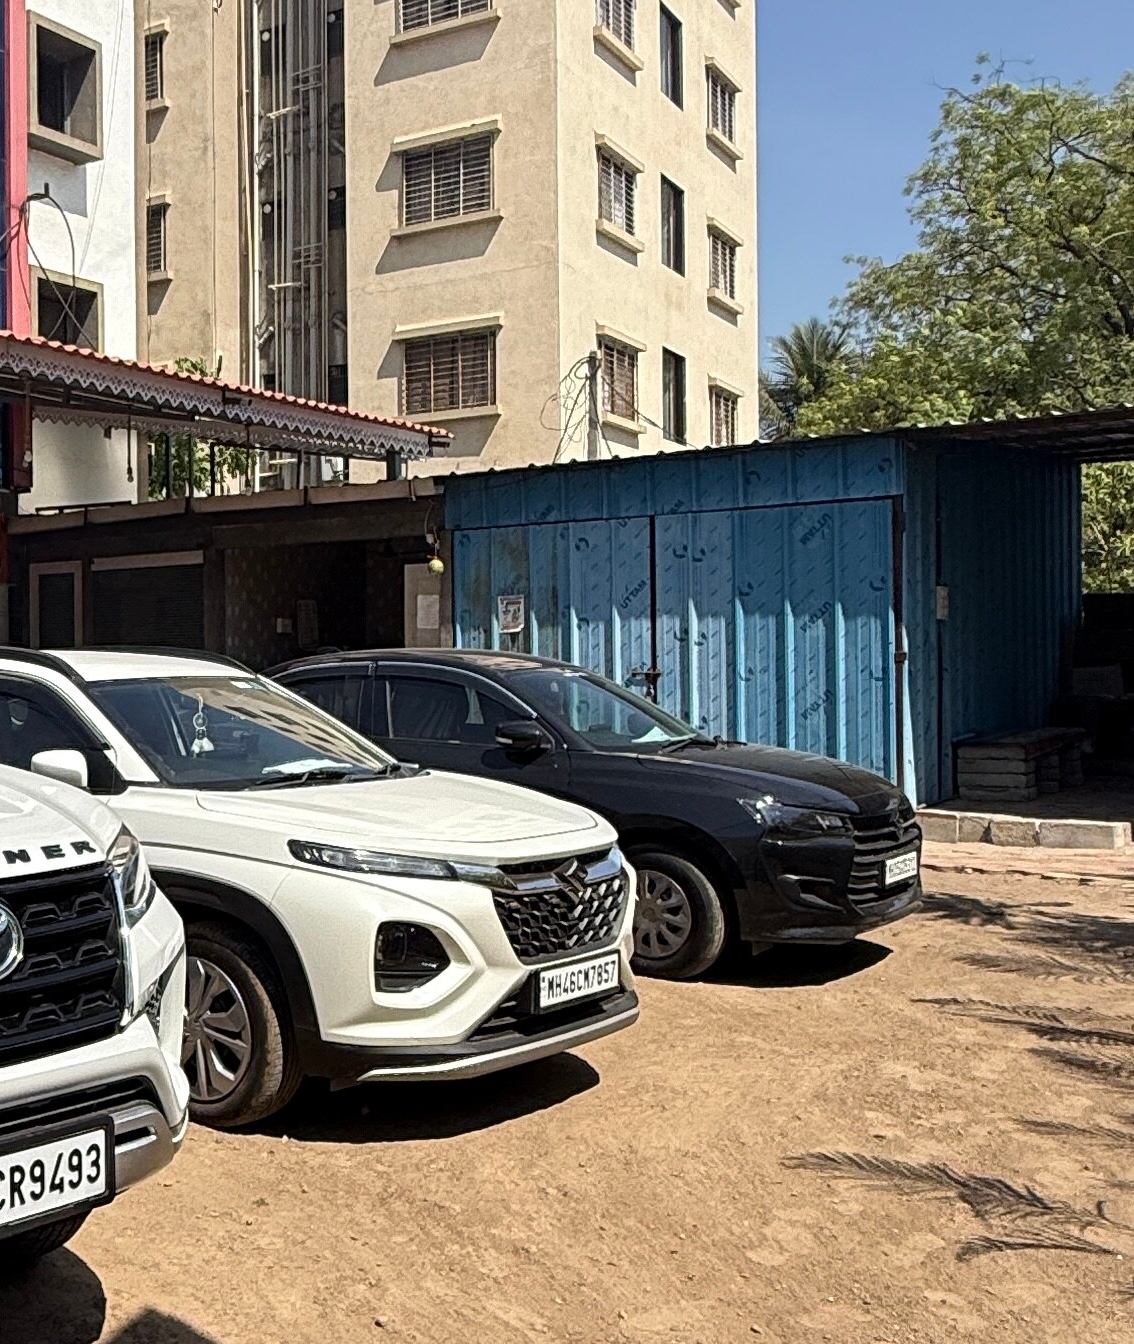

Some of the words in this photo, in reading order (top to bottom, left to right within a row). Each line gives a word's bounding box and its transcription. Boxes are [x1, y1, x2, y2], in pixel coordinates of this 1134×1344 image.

[799, 513, 833, 546] UTTAM
[621, 579, 649, 609] UTTAM
[547, 960, 616, 1000] MH46CM7857
